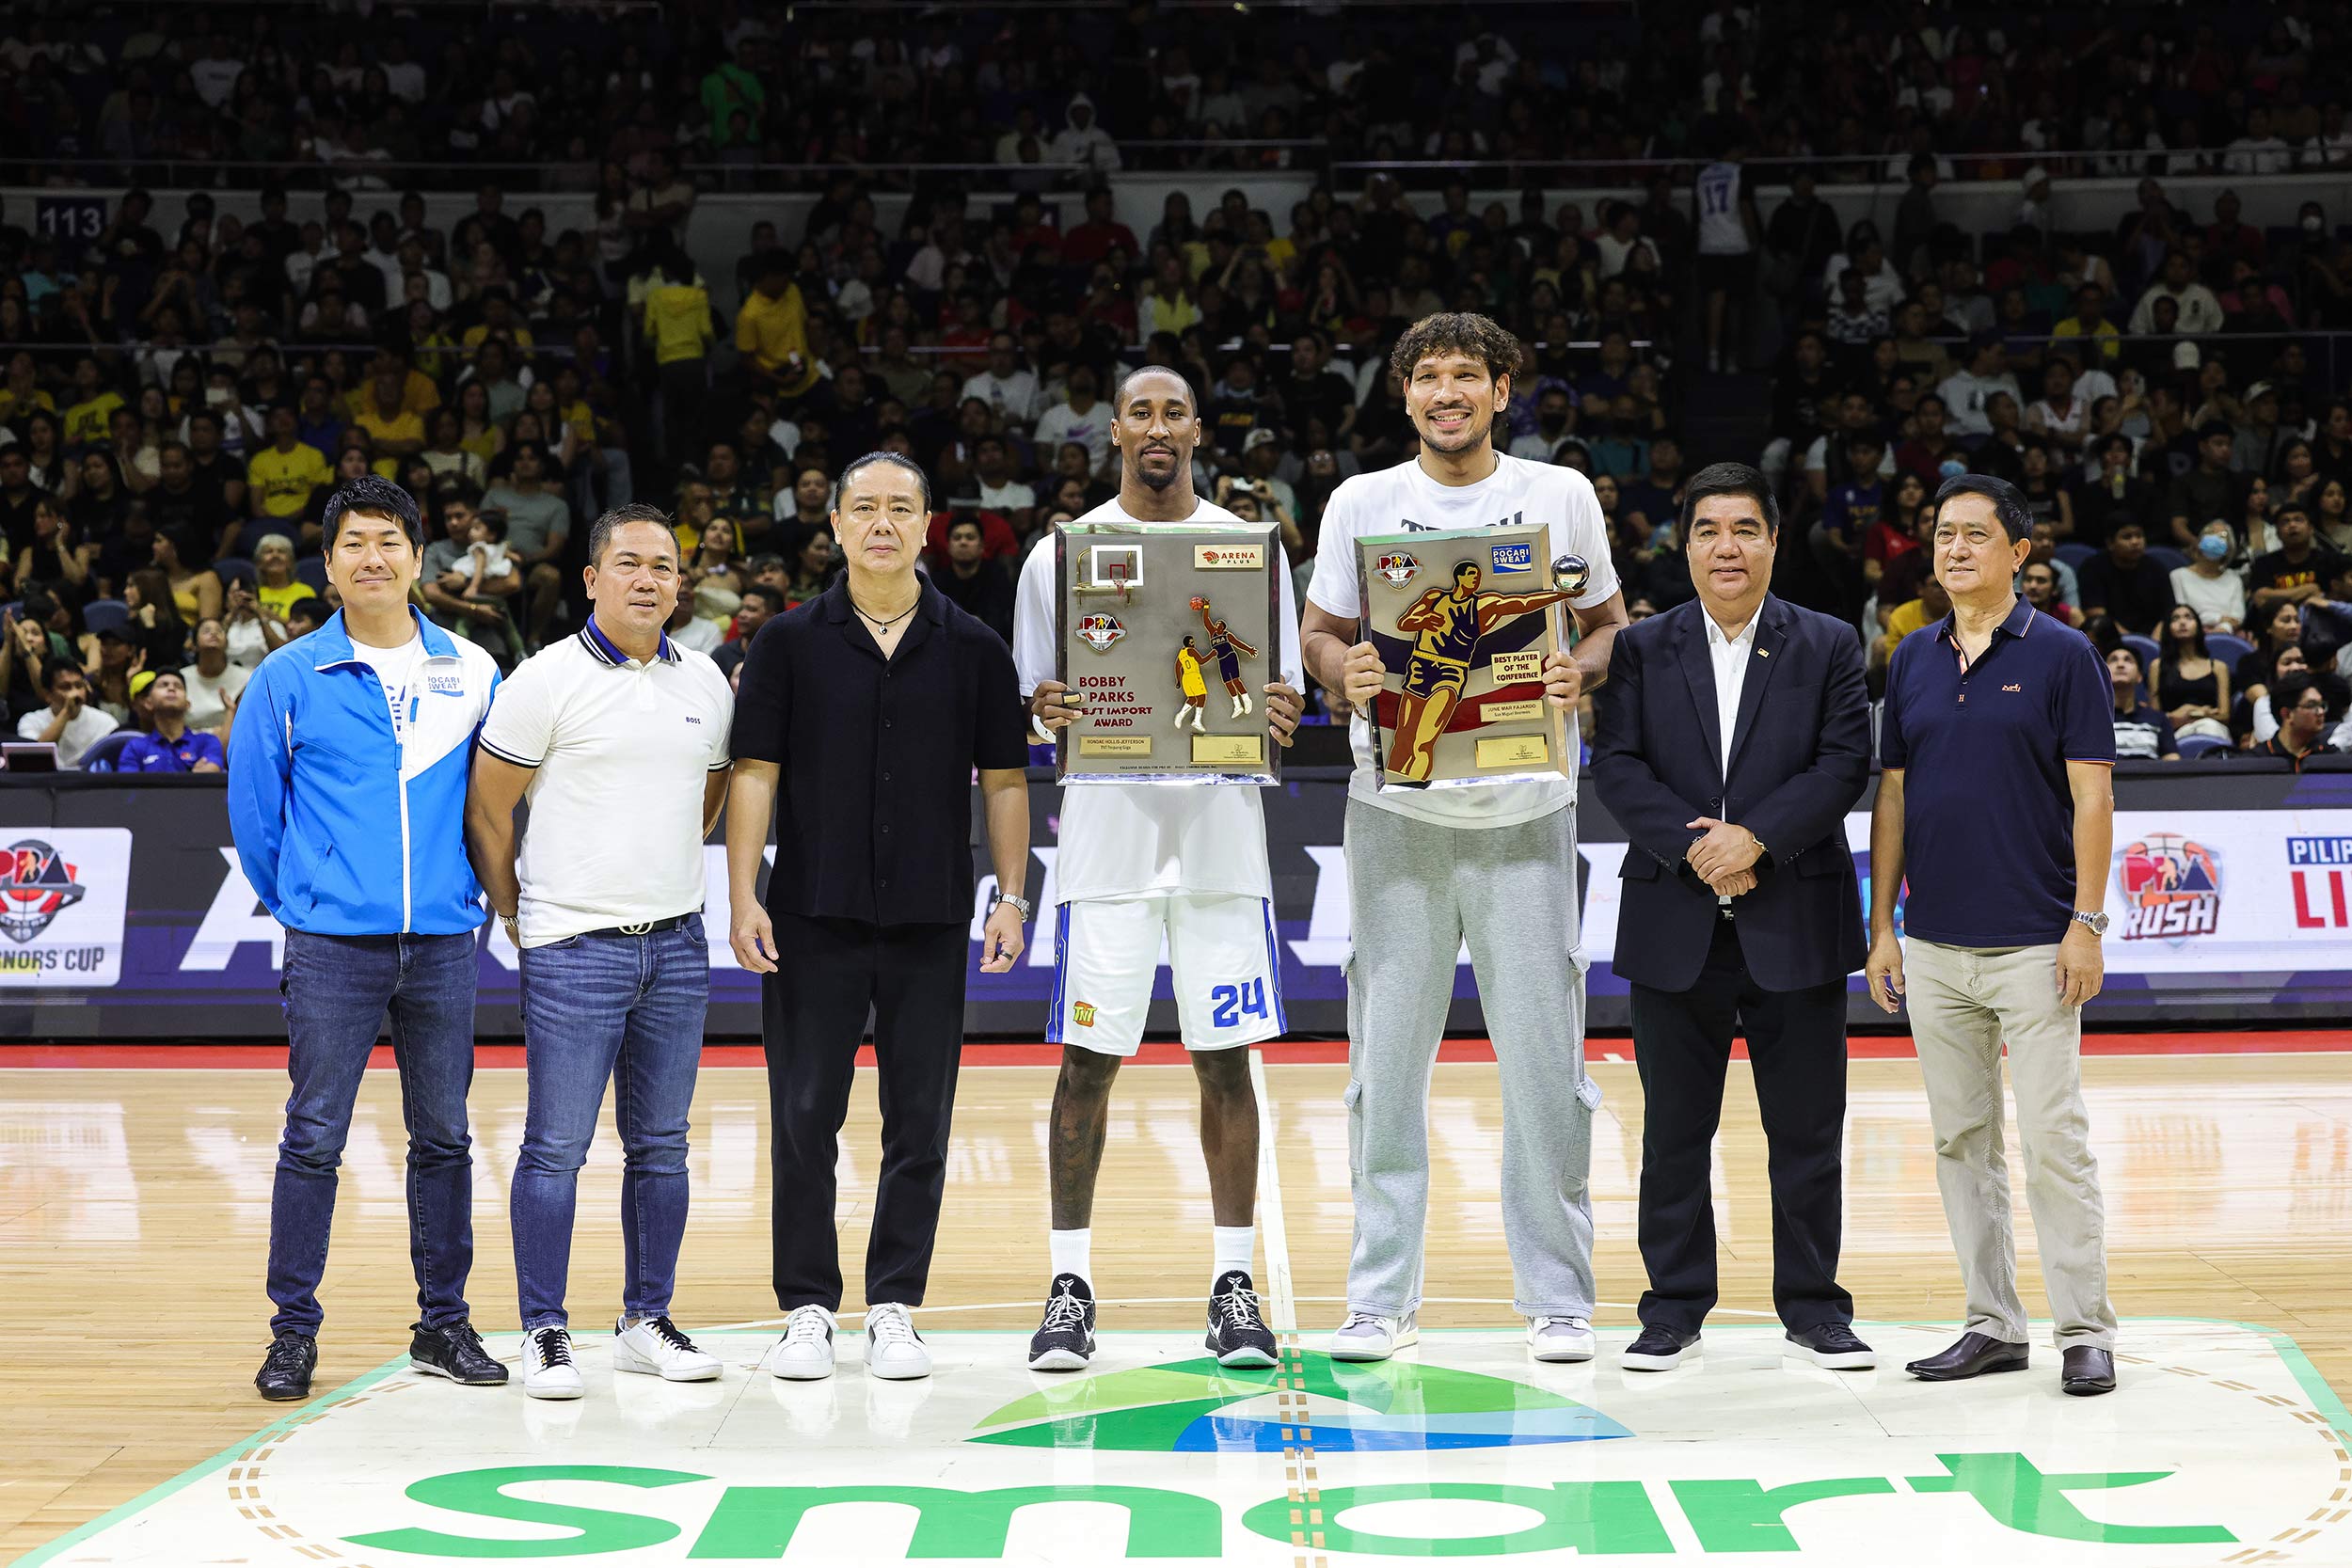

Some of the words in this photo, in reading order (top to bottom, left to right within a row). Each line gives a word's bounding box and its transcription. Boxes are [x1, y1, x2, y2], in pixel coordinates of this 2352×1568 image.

[40, 206, 102, 238] 113
[1493, 548, 1529, 557] POCARI
[1379, 554, 1417, 570] PBA
[1082, 615, 1120, 630] PBA
[1212, 637, 1226, 645] PBA
[1079, 676, 1126, 688] BOBBY
[1496, 672, 1538, 681] CONFERENCE
[1089, 691, 1135, 703] PARKS
[1094, 719, 1133, 727] AWARD
[2124, 855, 2216, 892] PBA
[2121, 896, 2217, 939] RUSH
[0, 949, 63, 971] NORS'
[64, 946, 104, 973] CUP
[1211, 976, 1268, 1028] 24
[1073, 1005, 1098, 1023] TNT
[337, 1452, 2242, 1559] smart
